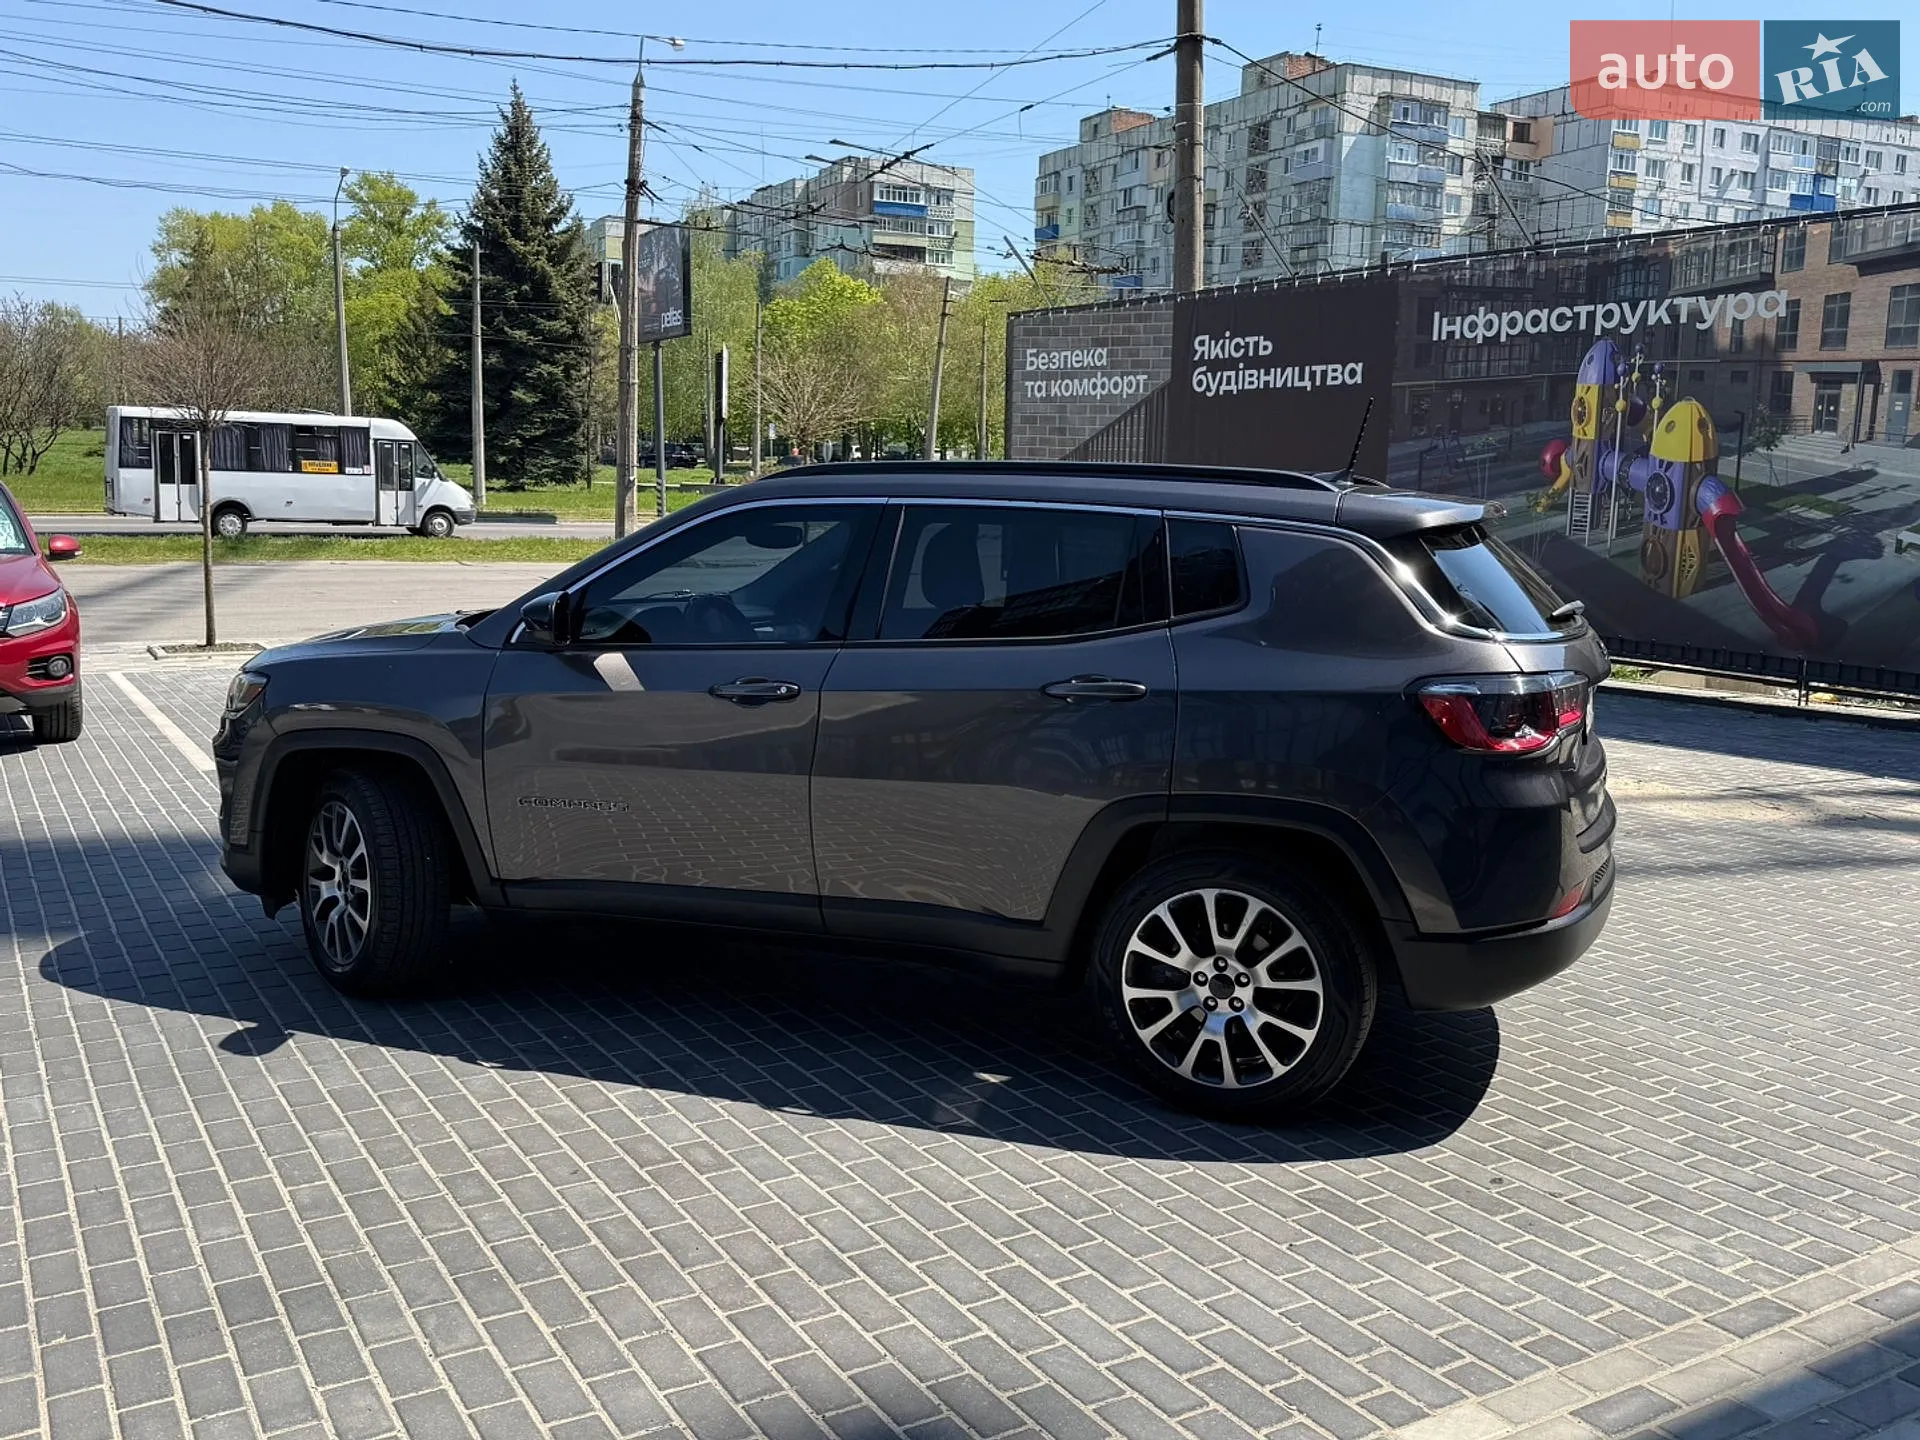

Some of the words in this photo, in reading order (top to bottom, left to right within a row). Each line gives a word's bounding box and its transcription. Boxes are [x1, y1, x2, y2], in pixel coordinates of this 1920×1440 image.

[1432, 290, 1788, 344] Інфраструктура
[1025, 347, 1108, 371] Безпека
[1193, 331, 1273, 361] Якість
[1025, 381, 1048, 399] та
[1051, 373, 1148, 400] комфорт
[1191, 362, 1363, 398] будівництва
